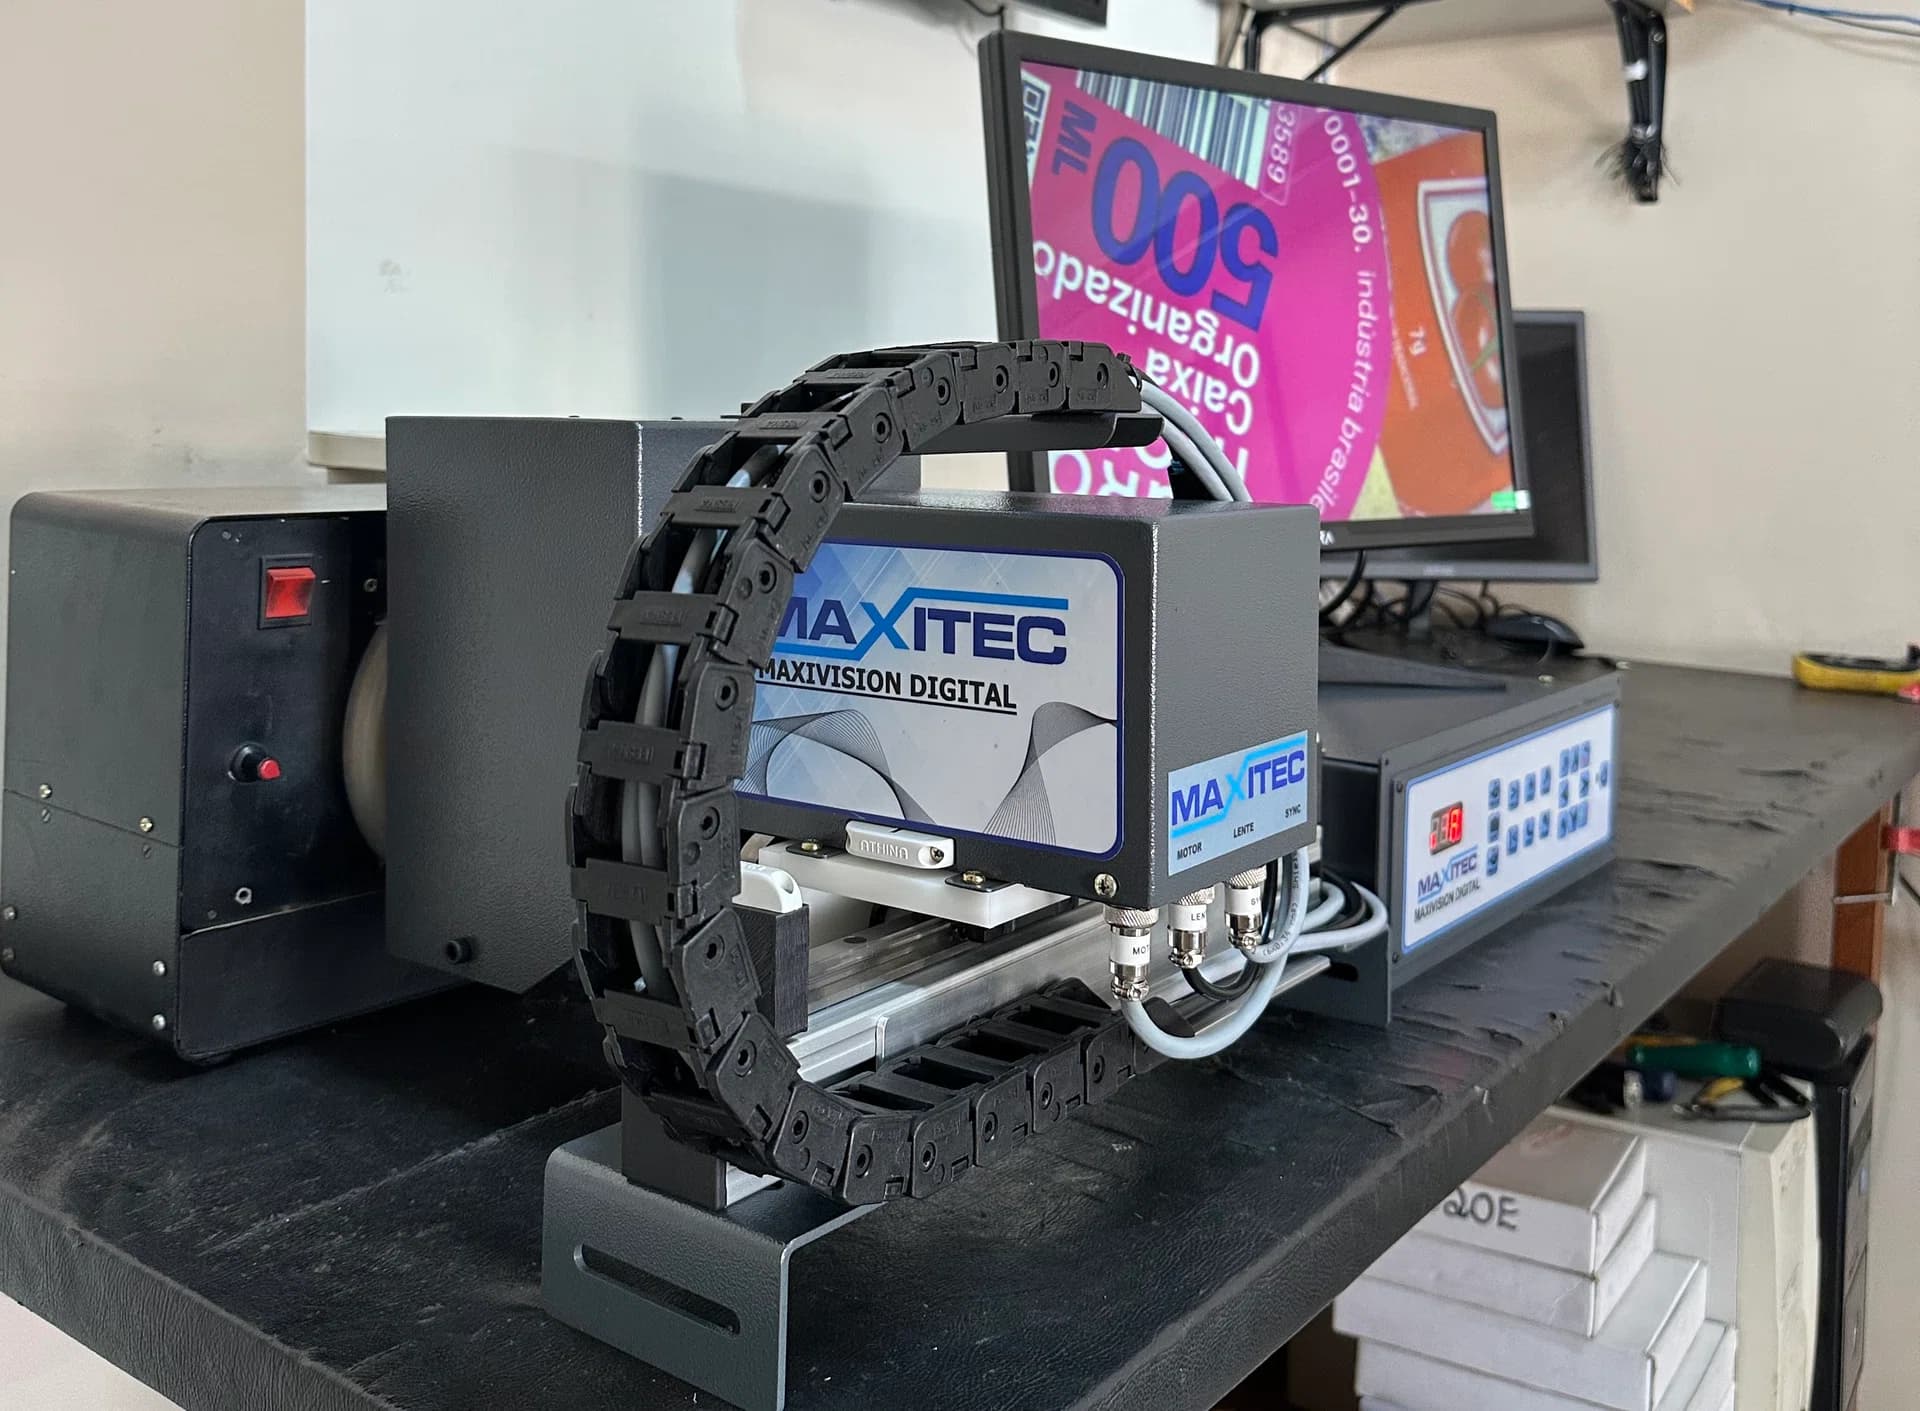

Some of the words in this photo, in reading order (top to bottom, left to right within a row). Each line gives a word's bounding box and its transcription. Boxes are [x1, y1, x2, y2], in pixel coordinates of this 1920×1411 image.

[1052, 98, 1098, 176] ML
[1317, 108, 1372, 253] 0001-30.
[1091, 136, 1279, 333] 500
[1146, 347, 1252, 436] Caixa
[910, 673, 1018, 709] DIGITAL
[1171, 750, 1305, 826] MAXITEC
[860, 840, 909, 860] ATHINA
[1177, 842, 1202, 860] MOTOR
[1233, 822, 1255, 838] LENTE
[1284, 804, 1302, 819] SYNC
[1418, 852, 1478, 897] MAXITEC
